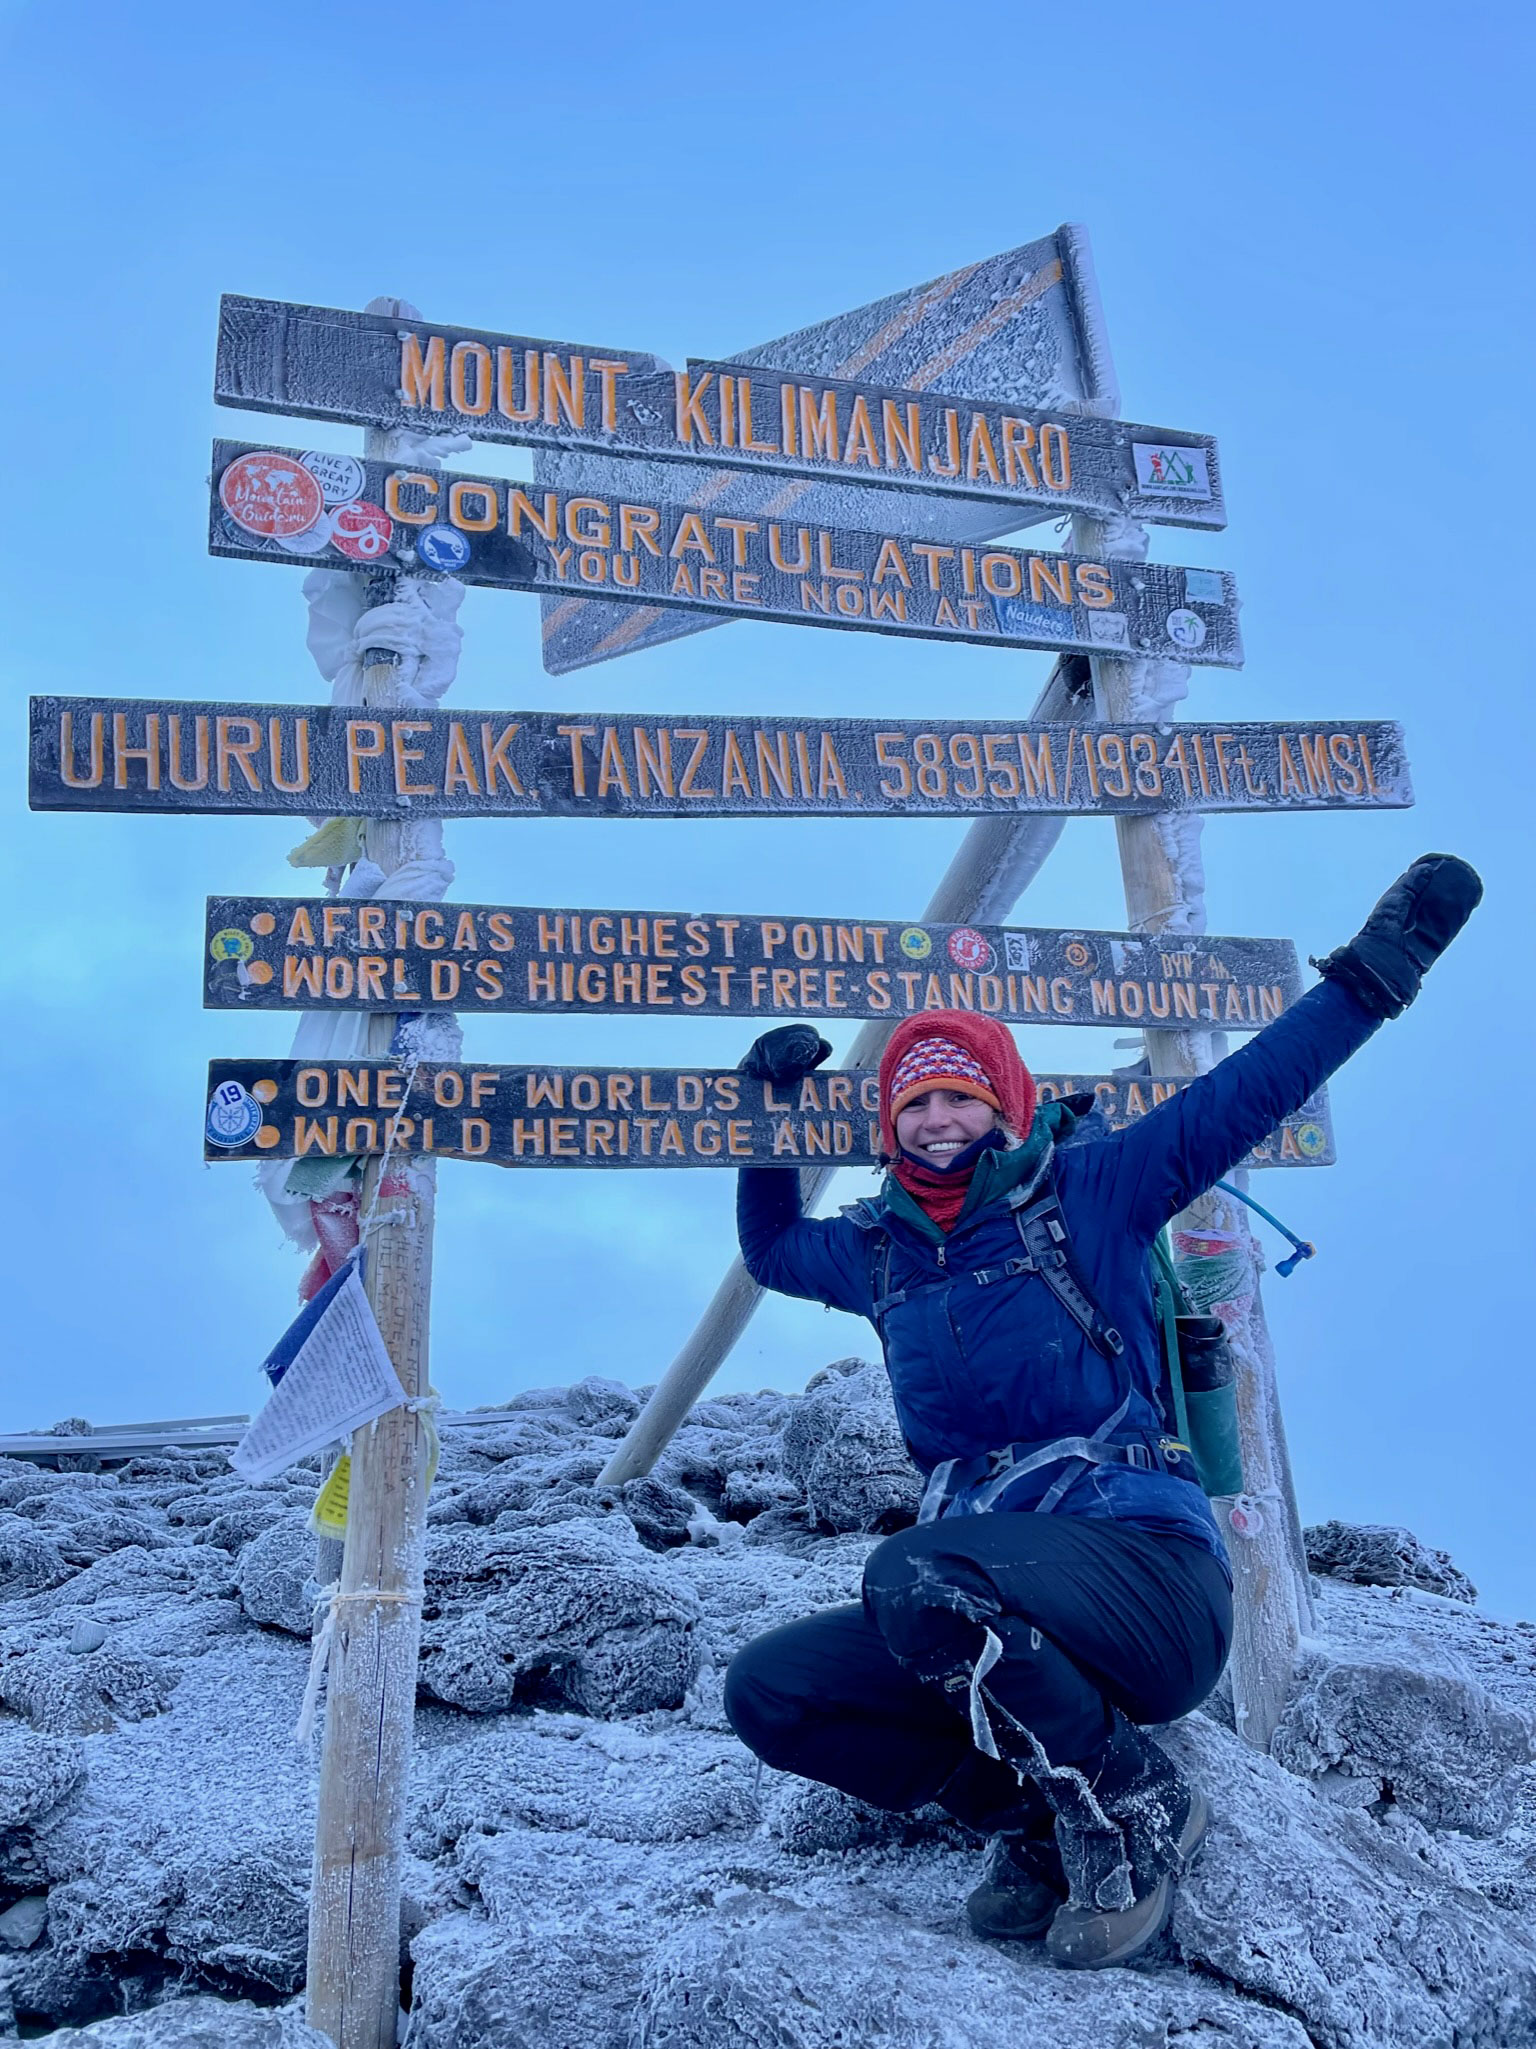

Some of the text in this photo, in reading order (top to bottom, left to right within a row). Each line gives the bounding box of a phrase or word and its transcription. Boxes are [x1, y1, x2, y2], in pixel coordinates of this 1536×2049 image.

[401, 332, 1073, 491] MOUNT KILIMANJARO
[310, 465, 351, 486] GREAT
[314, 453, 354, 475] LIVE A
[319, 480, 348, 497] ORY
[385, 472, 1116, 609] CONGRATULATIONS
[549, 545, 992, 631] YOU ARE NOW AT
[1005, 605, 1065, 633] Nauders
[60, 711, 310, 793] UHURU
[286, 905, 516, 952] AFRICA'S
[537, 913, 739, 960] HIGHEST
[761, 920, 890, 965] POINT
[282, 955, 1283, 1022] WORLD'S HIGHEST FREE-STANDING MOUNTAIN
[220, 1084, 242, 1106] 19
[295, 1067, 401, 1108] ONE
[433, 1070, 501, 1109] OF
[527, 1073, 741, 1112] WORLD'S
[763, 1076, 880, 1113] LARG
[512, 1117, 754, 1157] HERITAGE
[772, 1119, 854, 1156] AND
